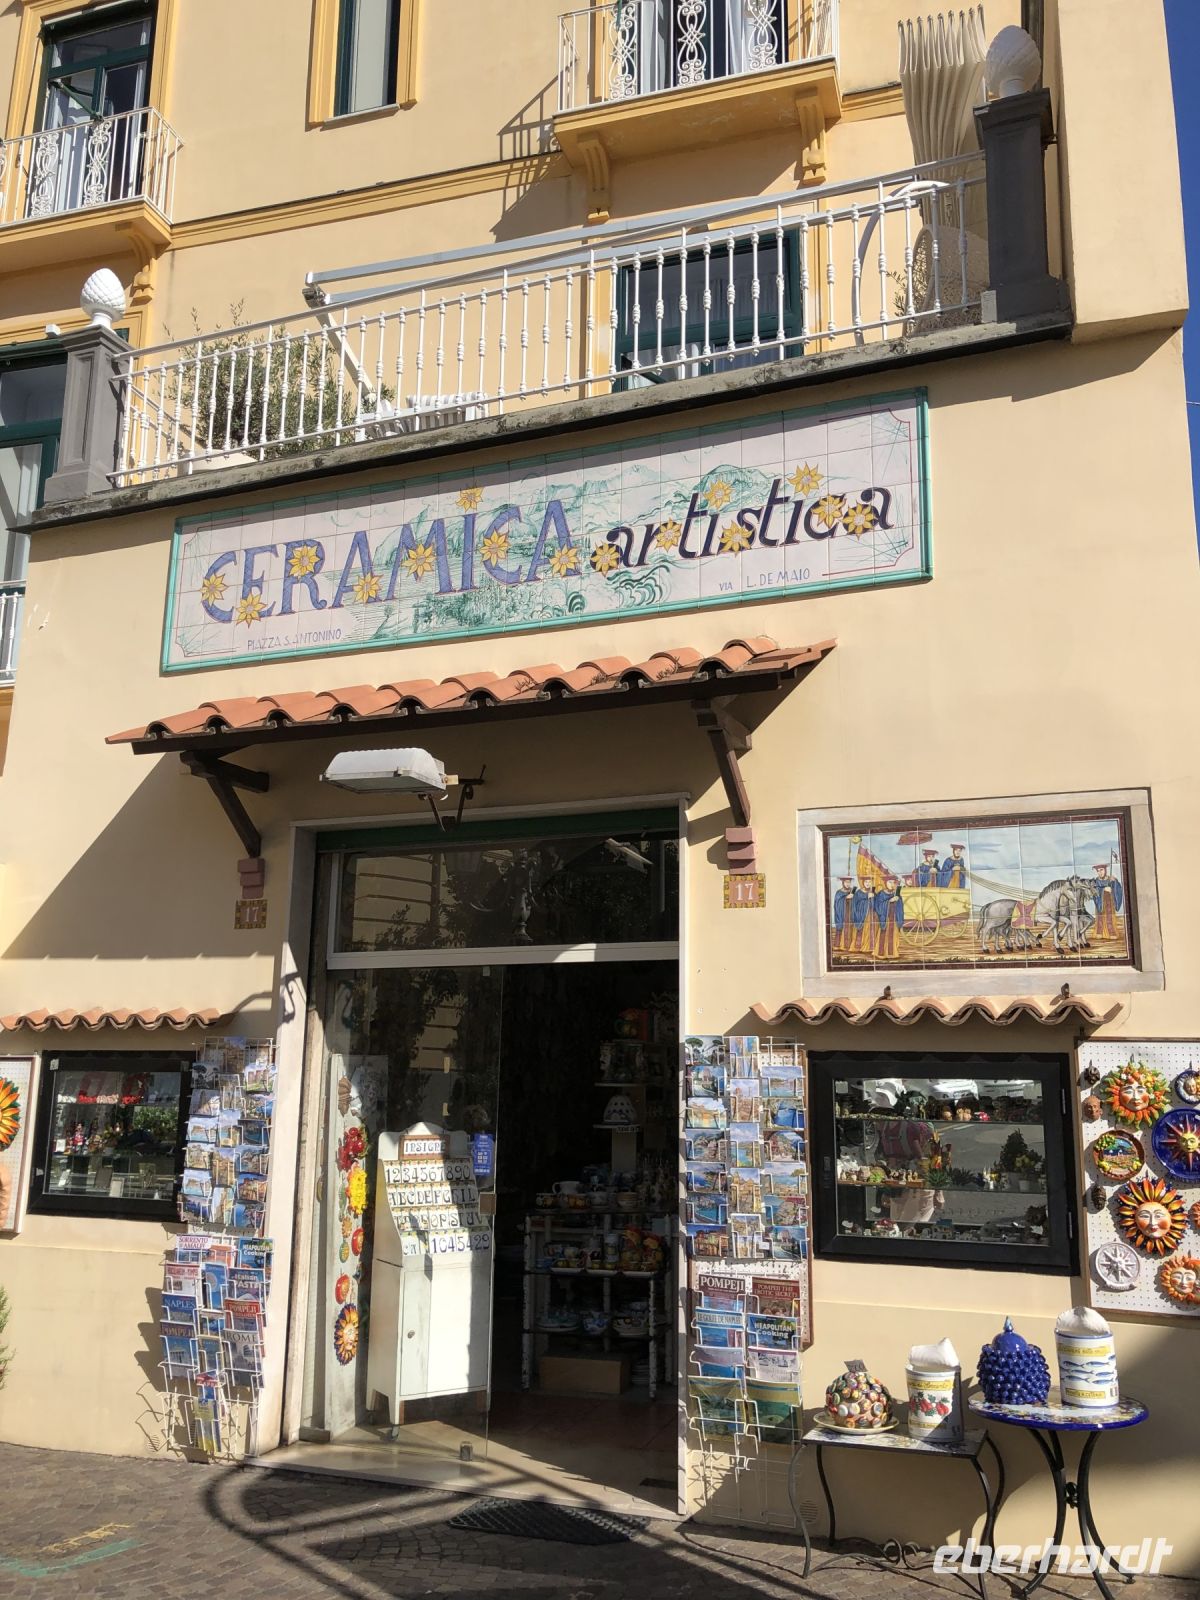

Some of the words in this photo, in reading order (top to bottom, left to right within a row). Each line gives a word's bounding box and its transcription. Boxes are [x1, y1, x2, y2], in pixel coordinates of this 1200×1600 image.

[201, 500, 582, 624] CERAMICA
[590, 470, 896, 569] artistica
[719, 581, 733, 591] VIA
[746, 576, 757, 588] L.
[759, 573, 774, 586] DE
[776, 567, 810, 583] MAIO
[247, 636, 281, 651] PIAZZA
[735, 883, 754, 901] 17
[246, 906, 259, 922] 17
[700, 1275, 744, 1292] POMPEJI
[163, 1298, 195, 1309] NAPLES
[754, 1322, 792, 1332] NEAPOLITAN
[757, 1329, 789, 1339] Cooking
